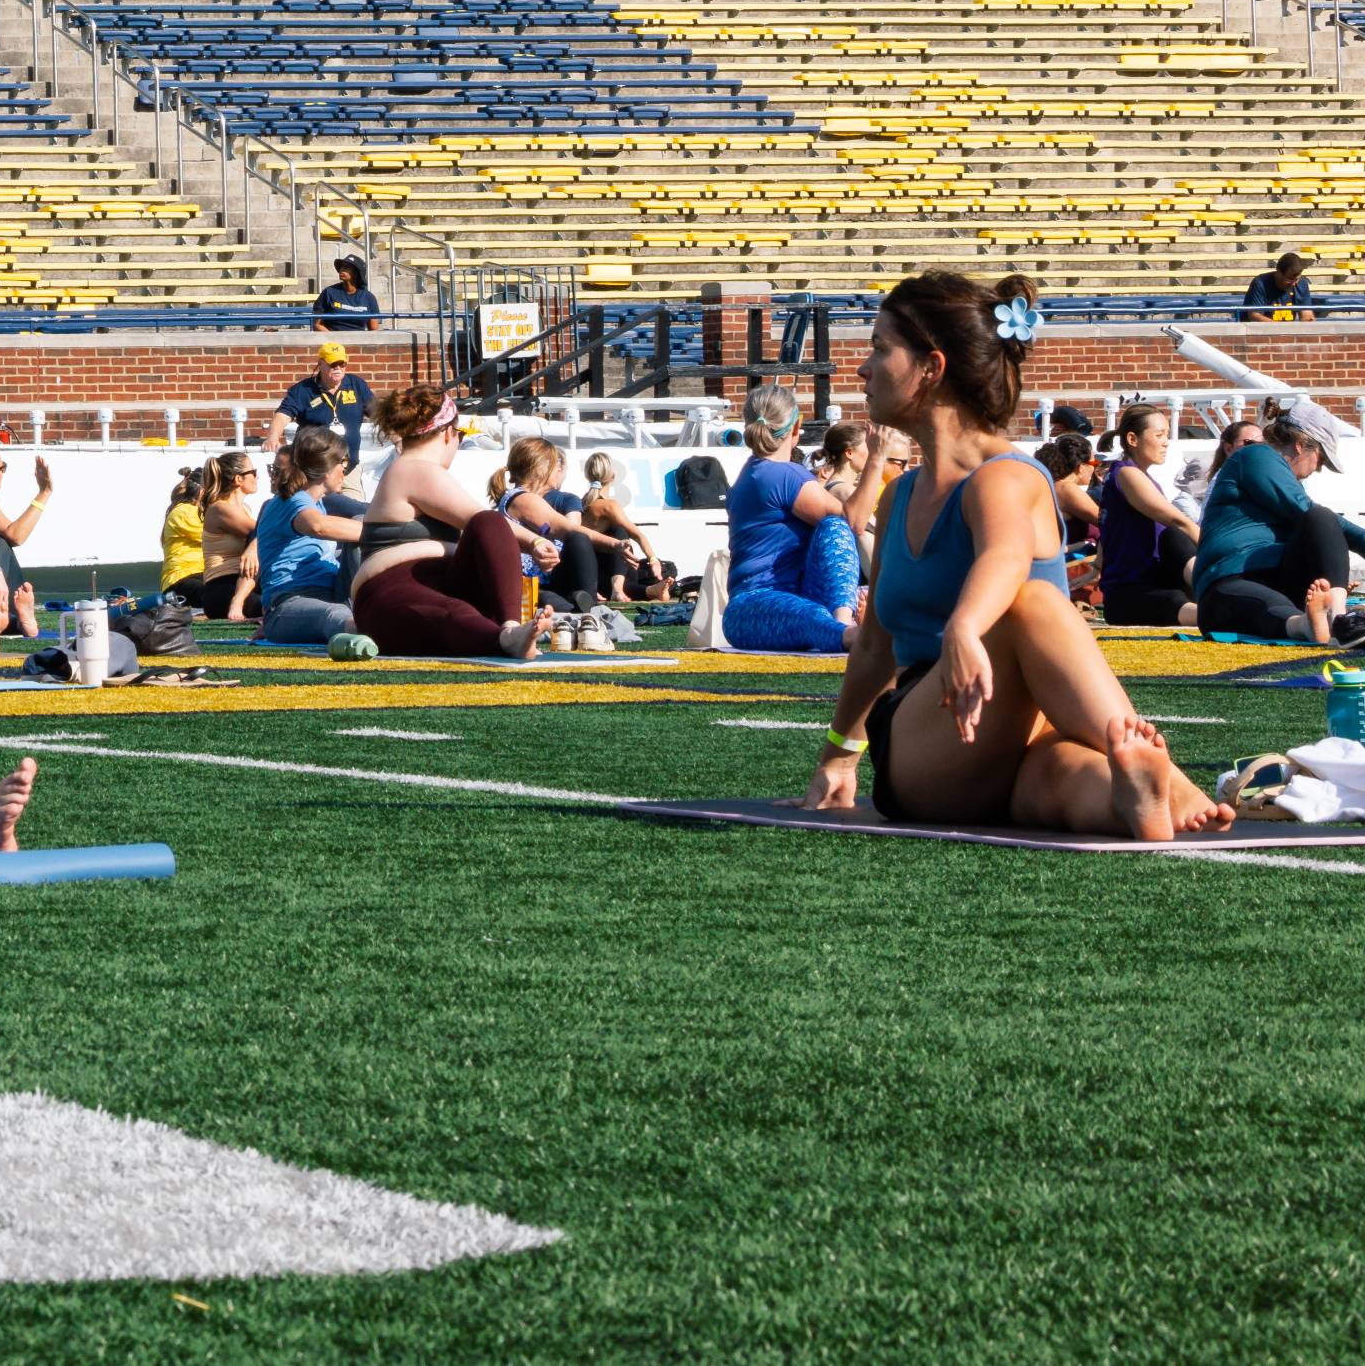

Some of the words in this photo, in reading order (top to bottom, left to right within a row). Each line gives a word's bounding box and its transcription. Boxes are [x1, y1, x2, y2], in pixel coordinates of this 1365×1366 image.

[487, 325, 511, 336] STAY
[515, 324, 534, 336] OFF
[484, 340, 503, 352] THE
